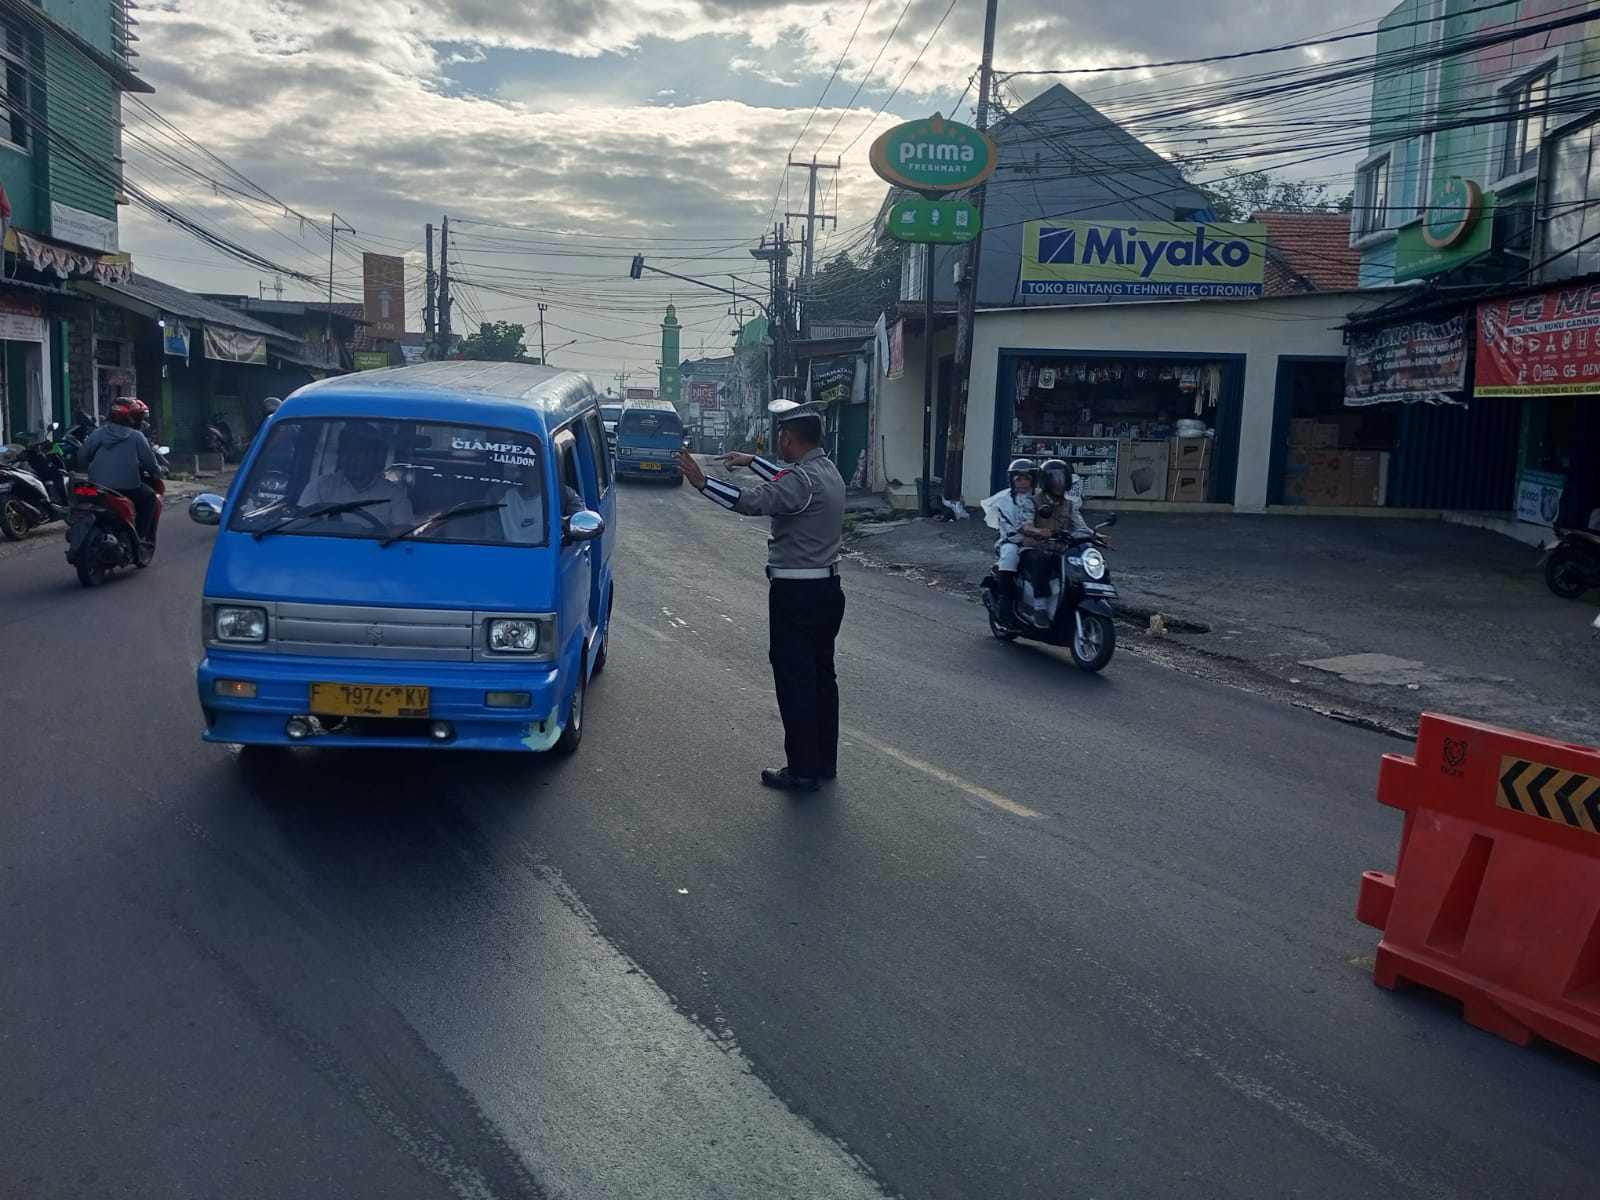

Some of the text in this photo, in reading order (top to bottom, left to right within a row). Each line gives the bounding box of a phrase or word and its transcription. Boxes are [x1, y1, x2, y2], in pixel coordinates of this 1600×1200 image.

[899, 142, 975, 163] prima
[1081, 226, 1251, 278] Miyako
[1028, 282, 1257, 297] TOKO BINTANG TEHNIK ELECTRONIK
[1504, 295, 1546, 326] FG
[1566, 317, 1600, 328] CADANG
[692, 387, 714, 397] NICE
[451, 440, 537, 456] CIAMPEA
